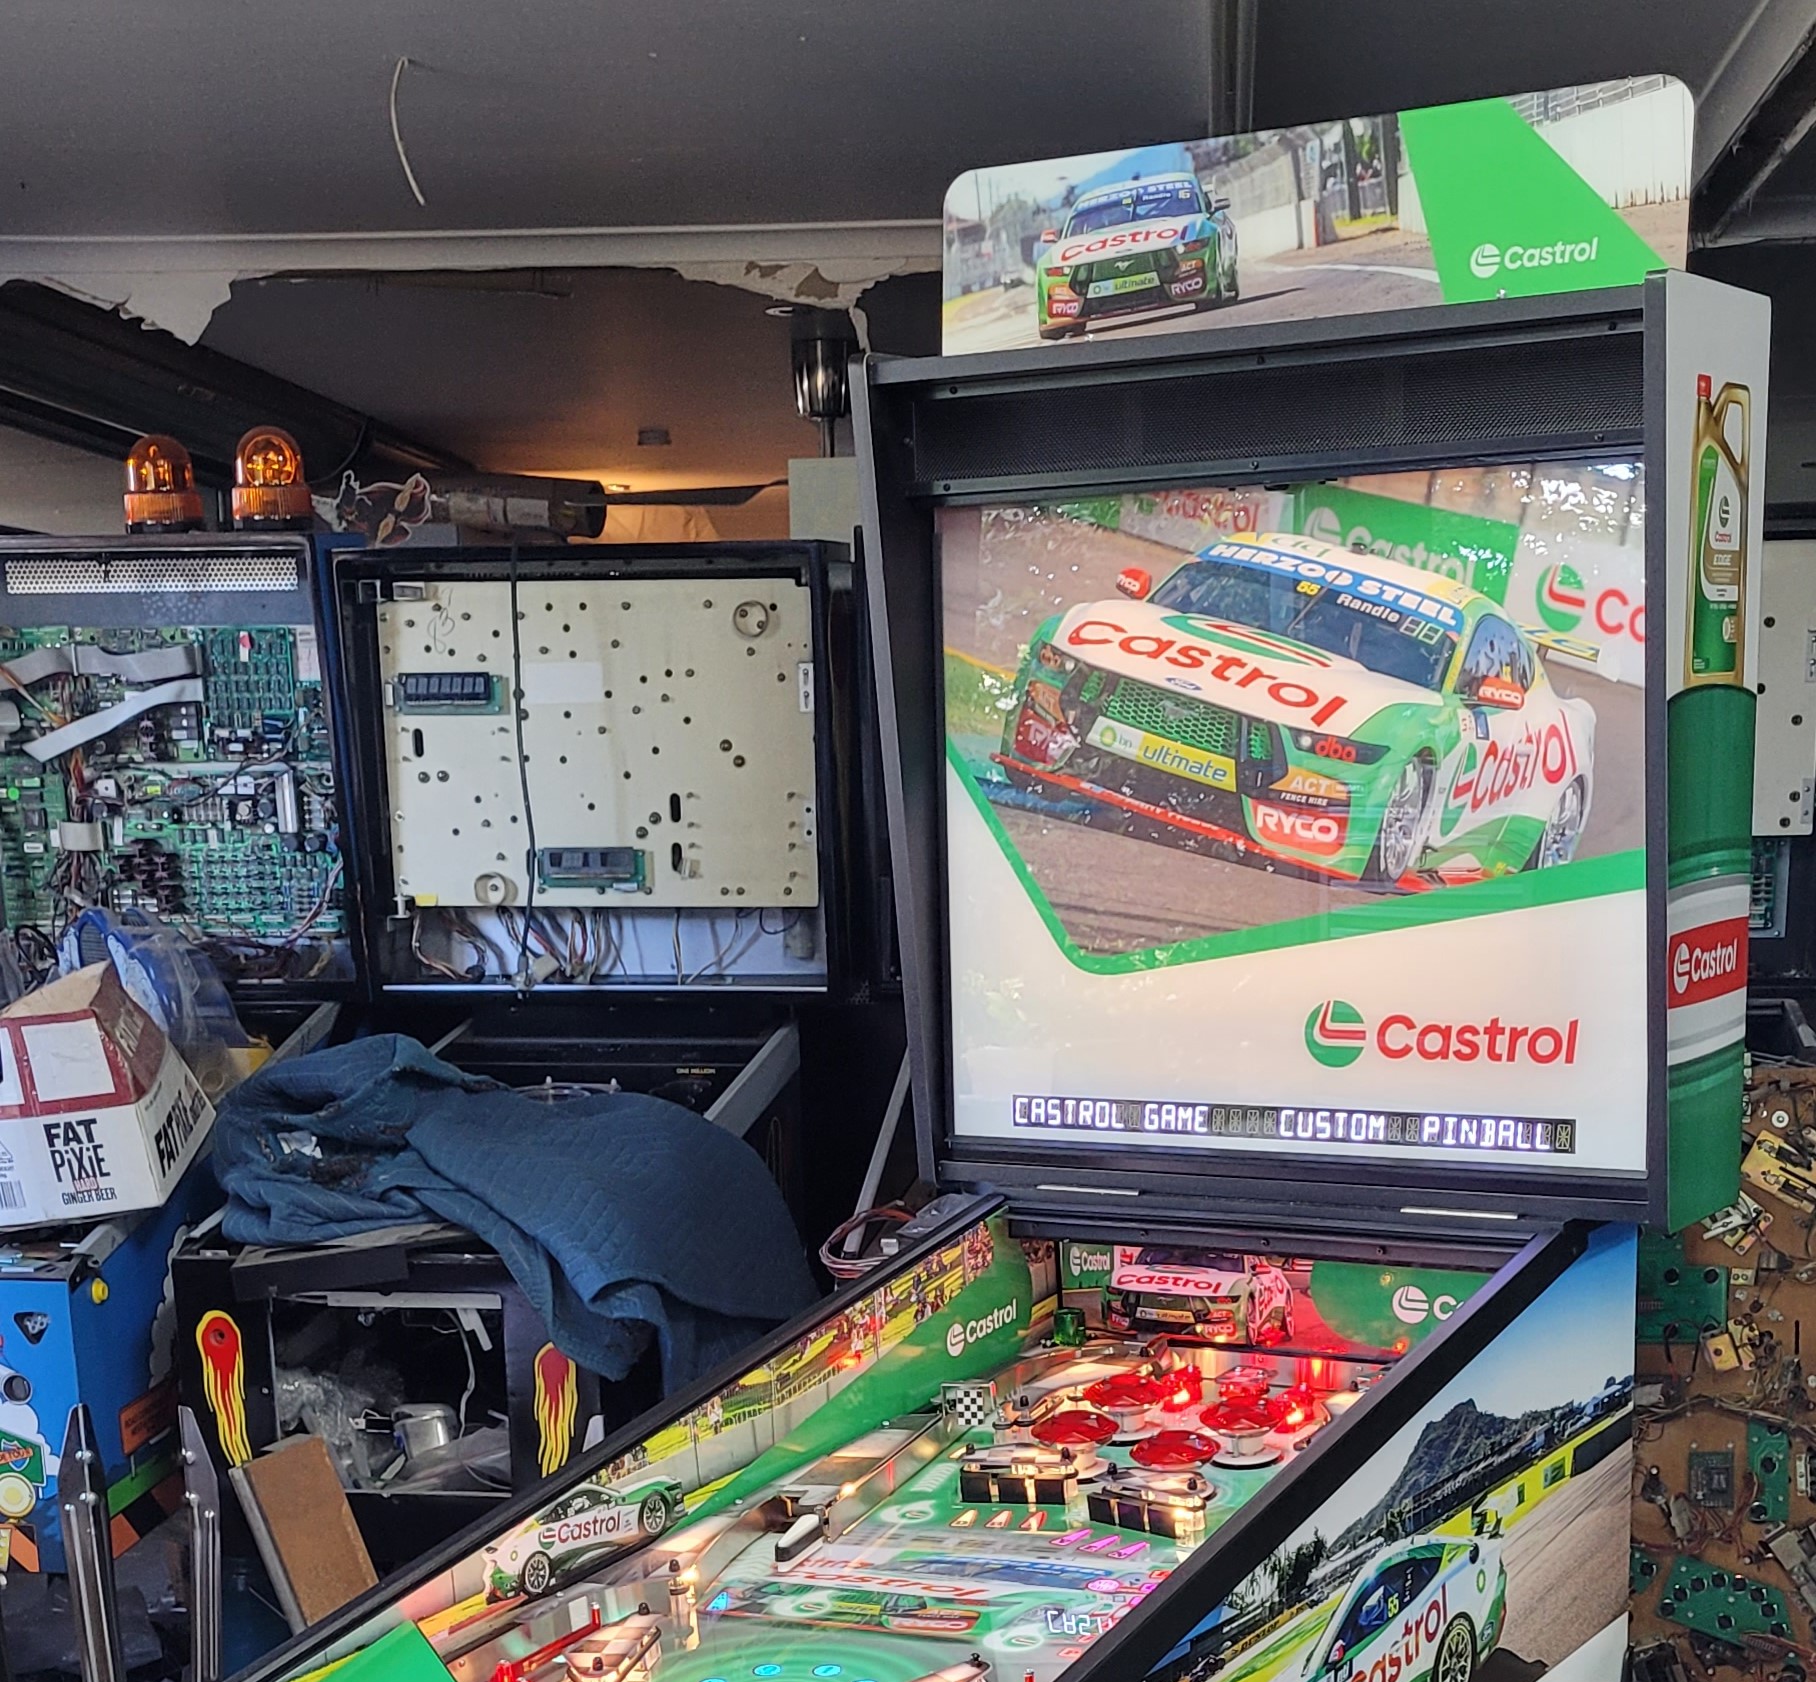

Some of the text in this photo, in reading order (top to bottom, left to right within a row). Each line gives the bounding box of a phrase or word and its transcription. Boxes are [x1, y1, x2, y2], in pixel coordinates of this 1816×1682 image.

[1061, 225, 1188, 261] Castrol
[1504, 236, 1599, 270] Castrol
[1171, 277, 1203, 295] RYCO
[1296, 581, 1320, 597] 55
[1356, 579, 1457, 626] STEEL
[1336, 593, 1400, 624] Randle
[1067, 620, 1348, 727] Castrol
[1143, 739, 1229, 782] ultimate
[1314, 737, 1357, 763] dba
[1289, 774, 1330, 796] ACT
[1256, 806, 1339, 842] RYCO
[1691, 937, 1738, 983] Castrol
[1377, 1014, 1580, 1065] Castrol
[43, 1118, 97, 1147] FAT
[1014, 1097, 1551, 1150] CASTROL GAME CUSTOM PINBALL
[62, 1187, 118, 1205] GINGER BEER
[73, 1177, 98, 1191] HARD
[1080, 1250, 1111, 1272] Castrol
[1117, 1274, 1222, 1294] Castrol
[966, 1299, 1017, 1344] Castrol
[557, 1510, 621, 1543] Castrol
